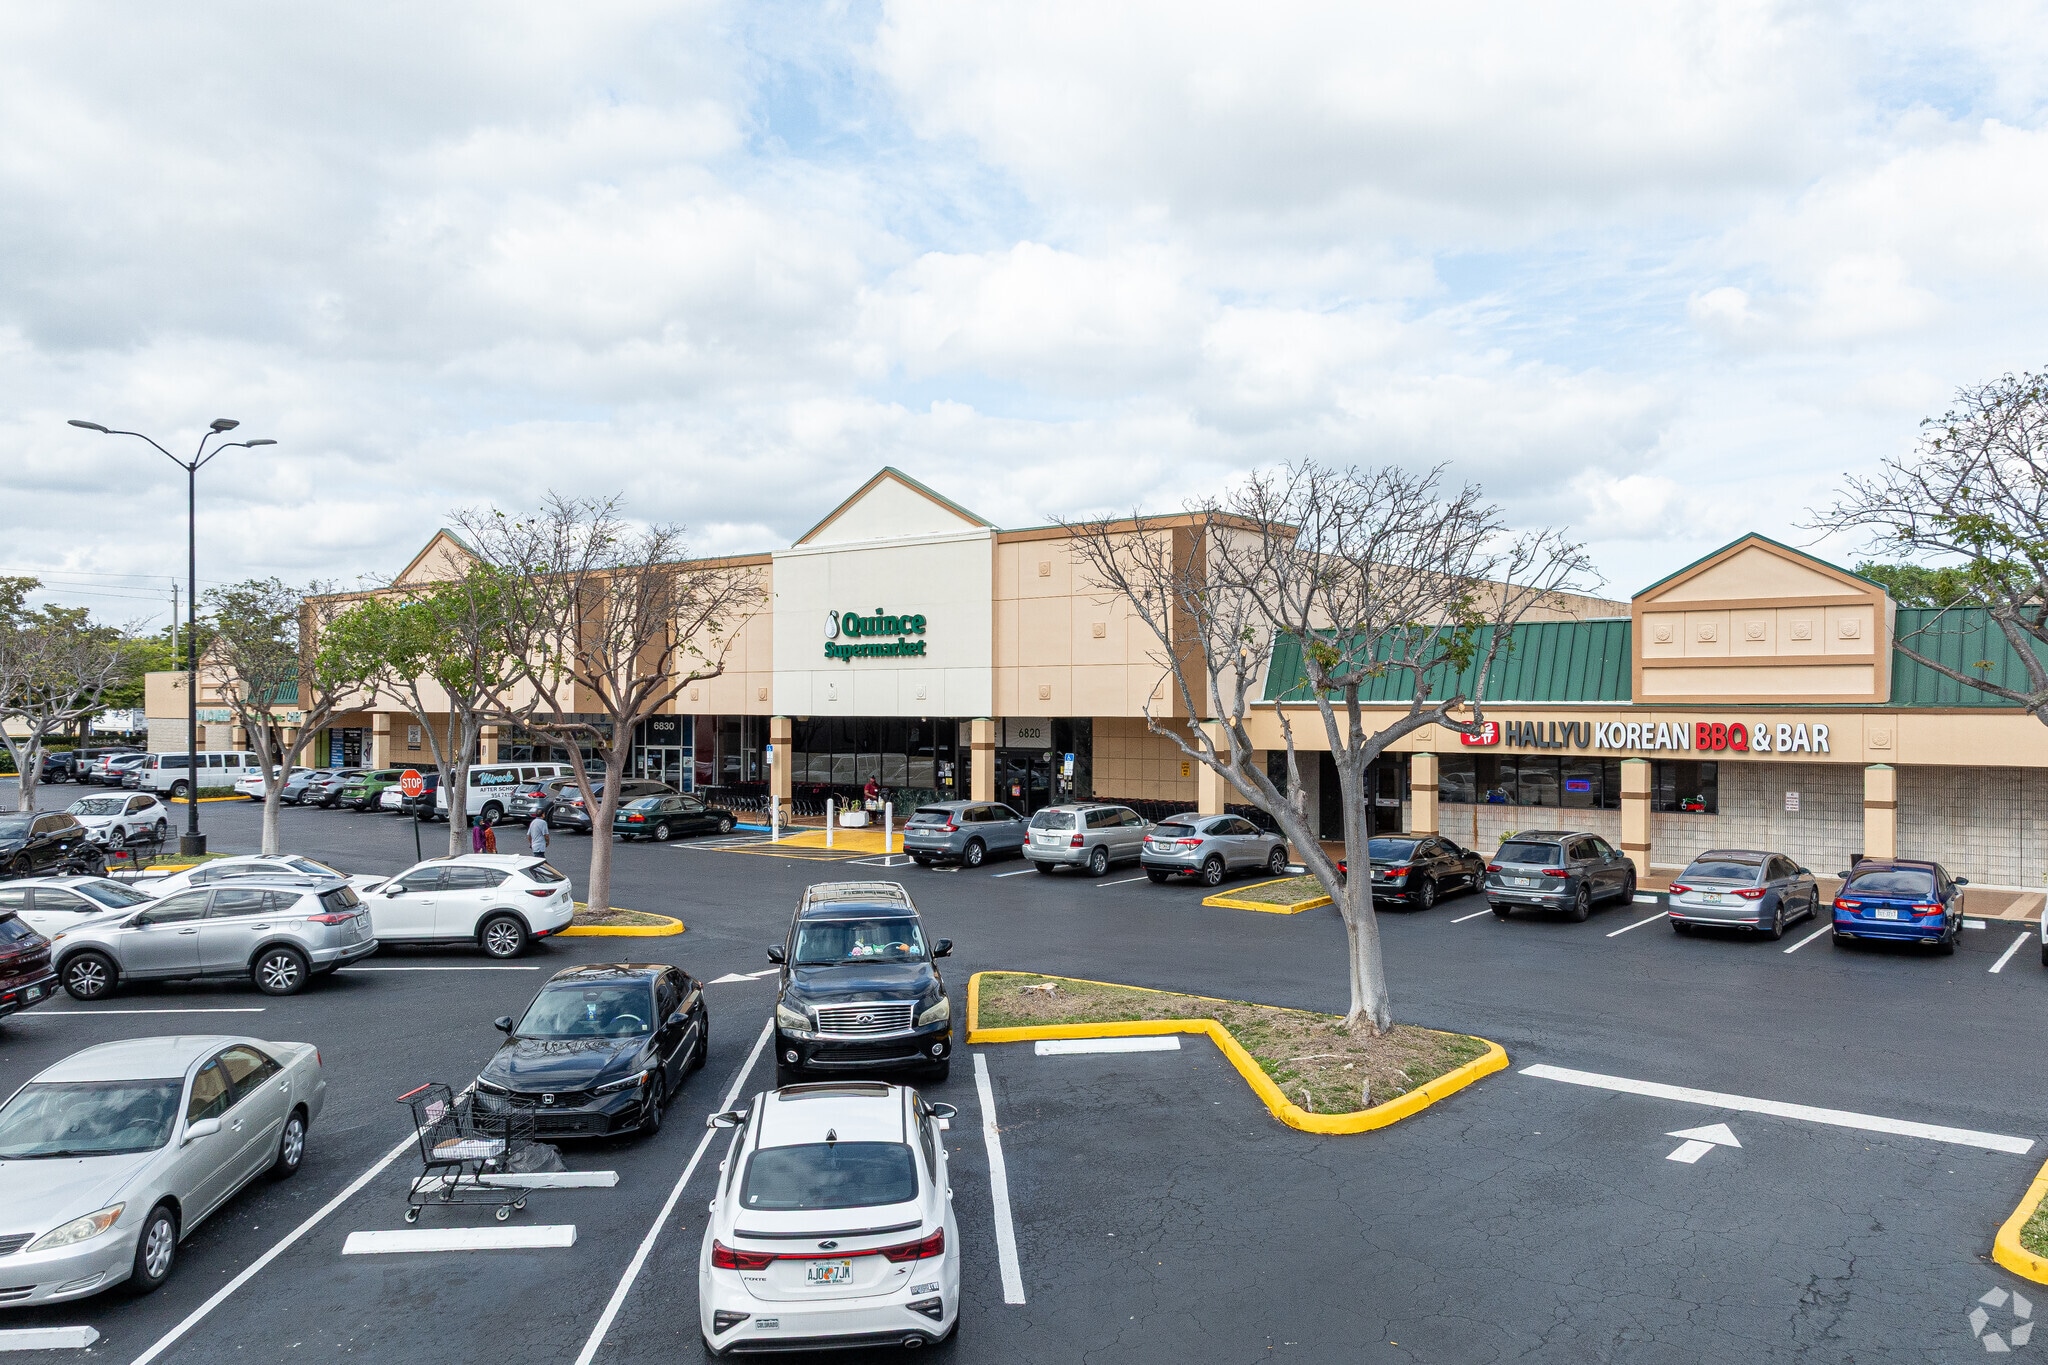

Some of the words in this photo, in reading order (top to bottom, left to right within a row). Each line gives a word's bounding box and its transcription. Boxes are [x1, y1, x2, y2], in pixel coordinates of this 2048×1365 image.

[842, 608, 926, 637] Quince
[824, 638, 926, 662] Supermarket
[653, 722, 675, 730] 6830
[1018, 728, 1040, 738] 6820
[1505, 721, 1591, 749] HALLYU
[1595, 722, 1690, 750] KOREAN
[1695, 722, 1749, 752] BBQ
[1752, 723, 1772, 752] &
[1776, 723, 1830, 753] BAR
[402, 778, 421, 788] STOP
[478, 771, 515, 785] Miracle
